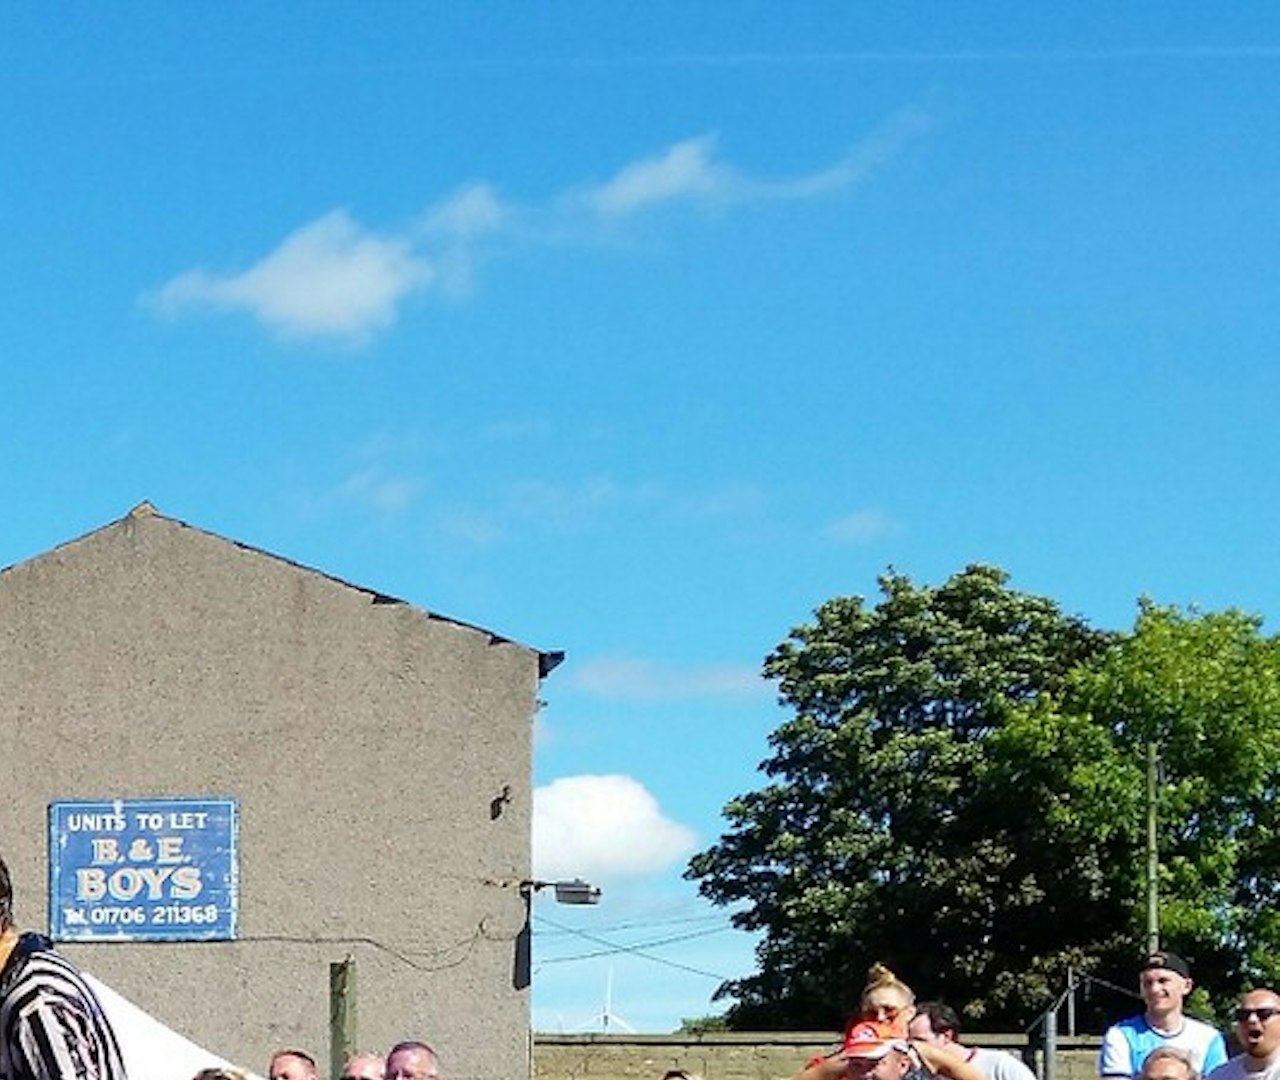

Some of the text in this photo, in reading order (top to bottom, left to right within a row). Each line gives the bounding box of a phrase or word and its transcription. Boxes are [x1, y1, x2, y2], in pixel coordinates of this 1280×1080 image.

[67, 812, 208, 832] UNITS TO LET
[128, 838, 154, 862] &
[75, 866, 203, 901] BOYS
[90, 906, 146, 925] 01706
[151, 902, 219, 924] 211368
